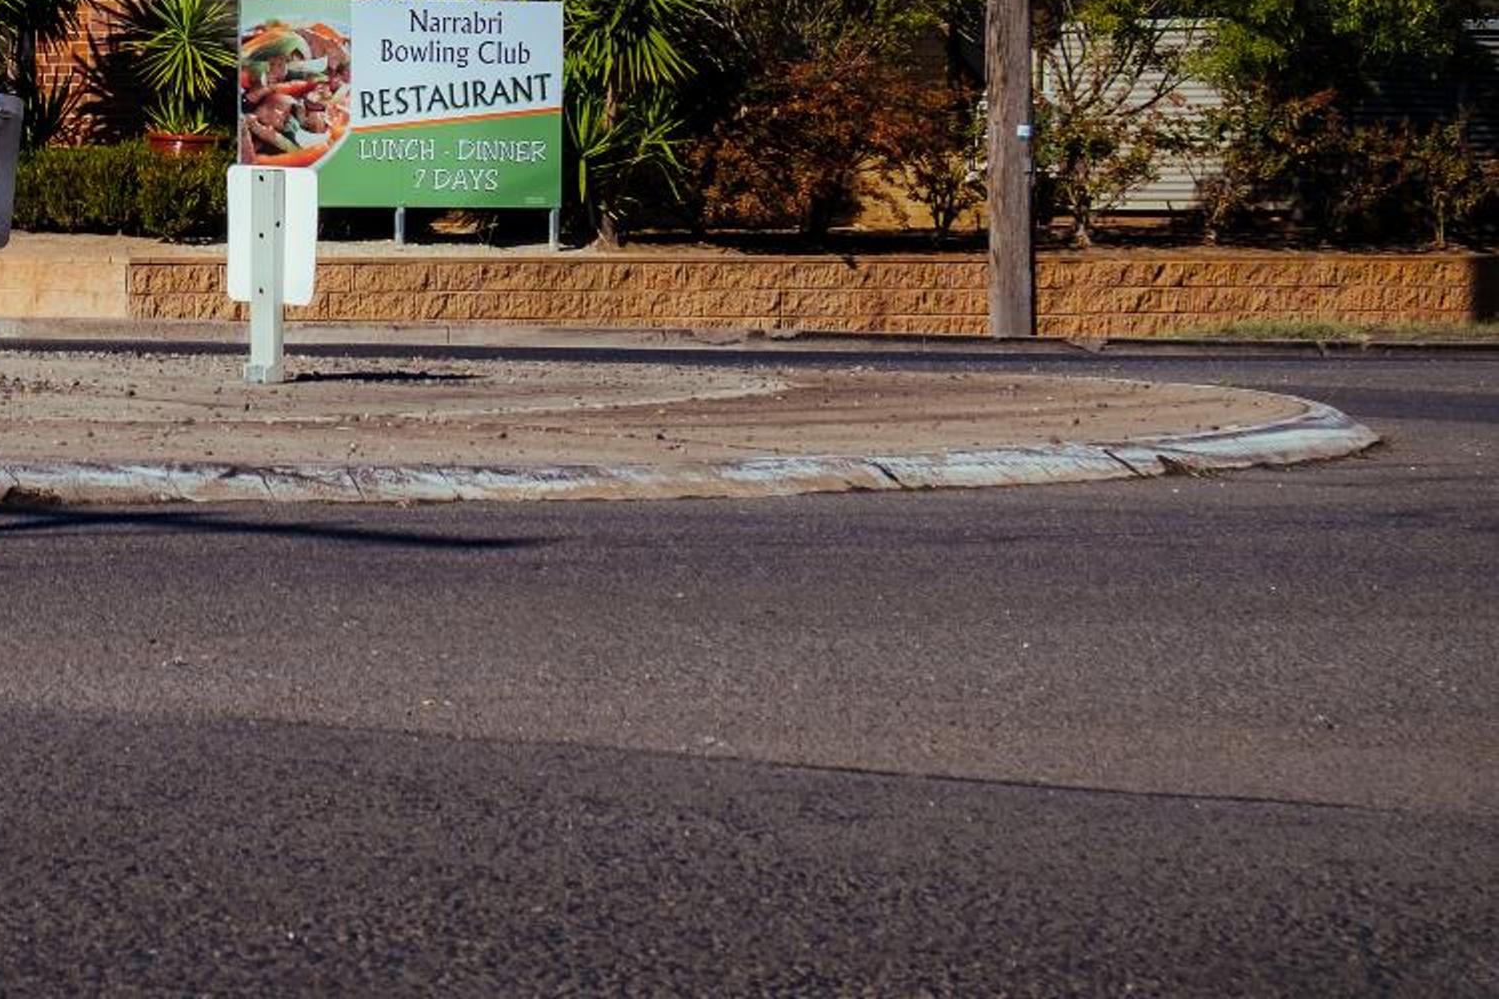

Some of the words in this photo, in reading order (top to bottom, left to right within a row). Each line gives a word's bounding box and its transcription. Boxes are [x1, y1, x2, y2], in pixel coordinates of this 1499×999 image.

[409, 9, 504, 35] Narrabri
[381, 39, 469, 68] Bowling
[478, 41, 531, 65] Club
[360, 72, 553, 120] RESTAURANT
[359, 138, 435, 161] LUNCH
[456, 139, 547, 162] DINNER
[413, 169, 426, 189] 7
[433, 169, 500, 191] DAYS
